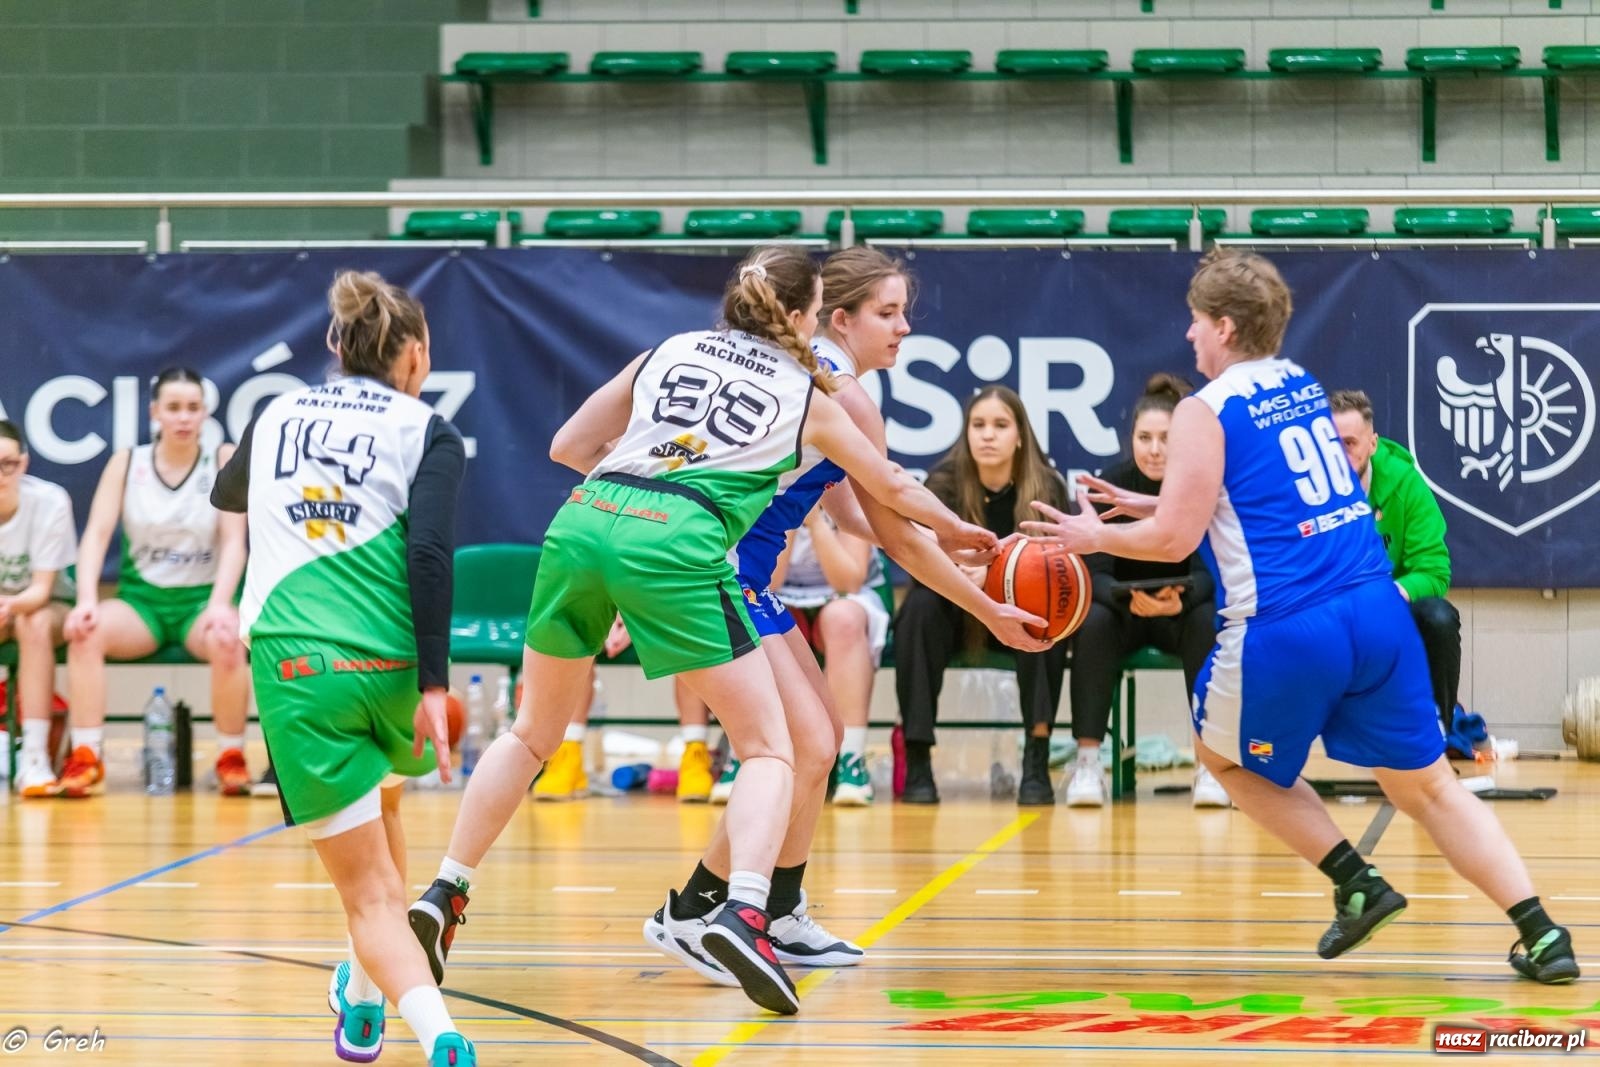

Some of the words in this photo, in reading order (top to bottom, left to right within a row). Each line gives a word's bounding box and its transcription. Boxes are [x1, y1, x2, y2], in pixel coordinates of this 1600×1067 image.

[858, 335, 1121, 456] SiR
[1247, 393, 1291, 418] MKS
[274, 417, 377, 486] 14
[1278, 415, 1355, 507] 96
[1055, 557, 1073, 620] molten
